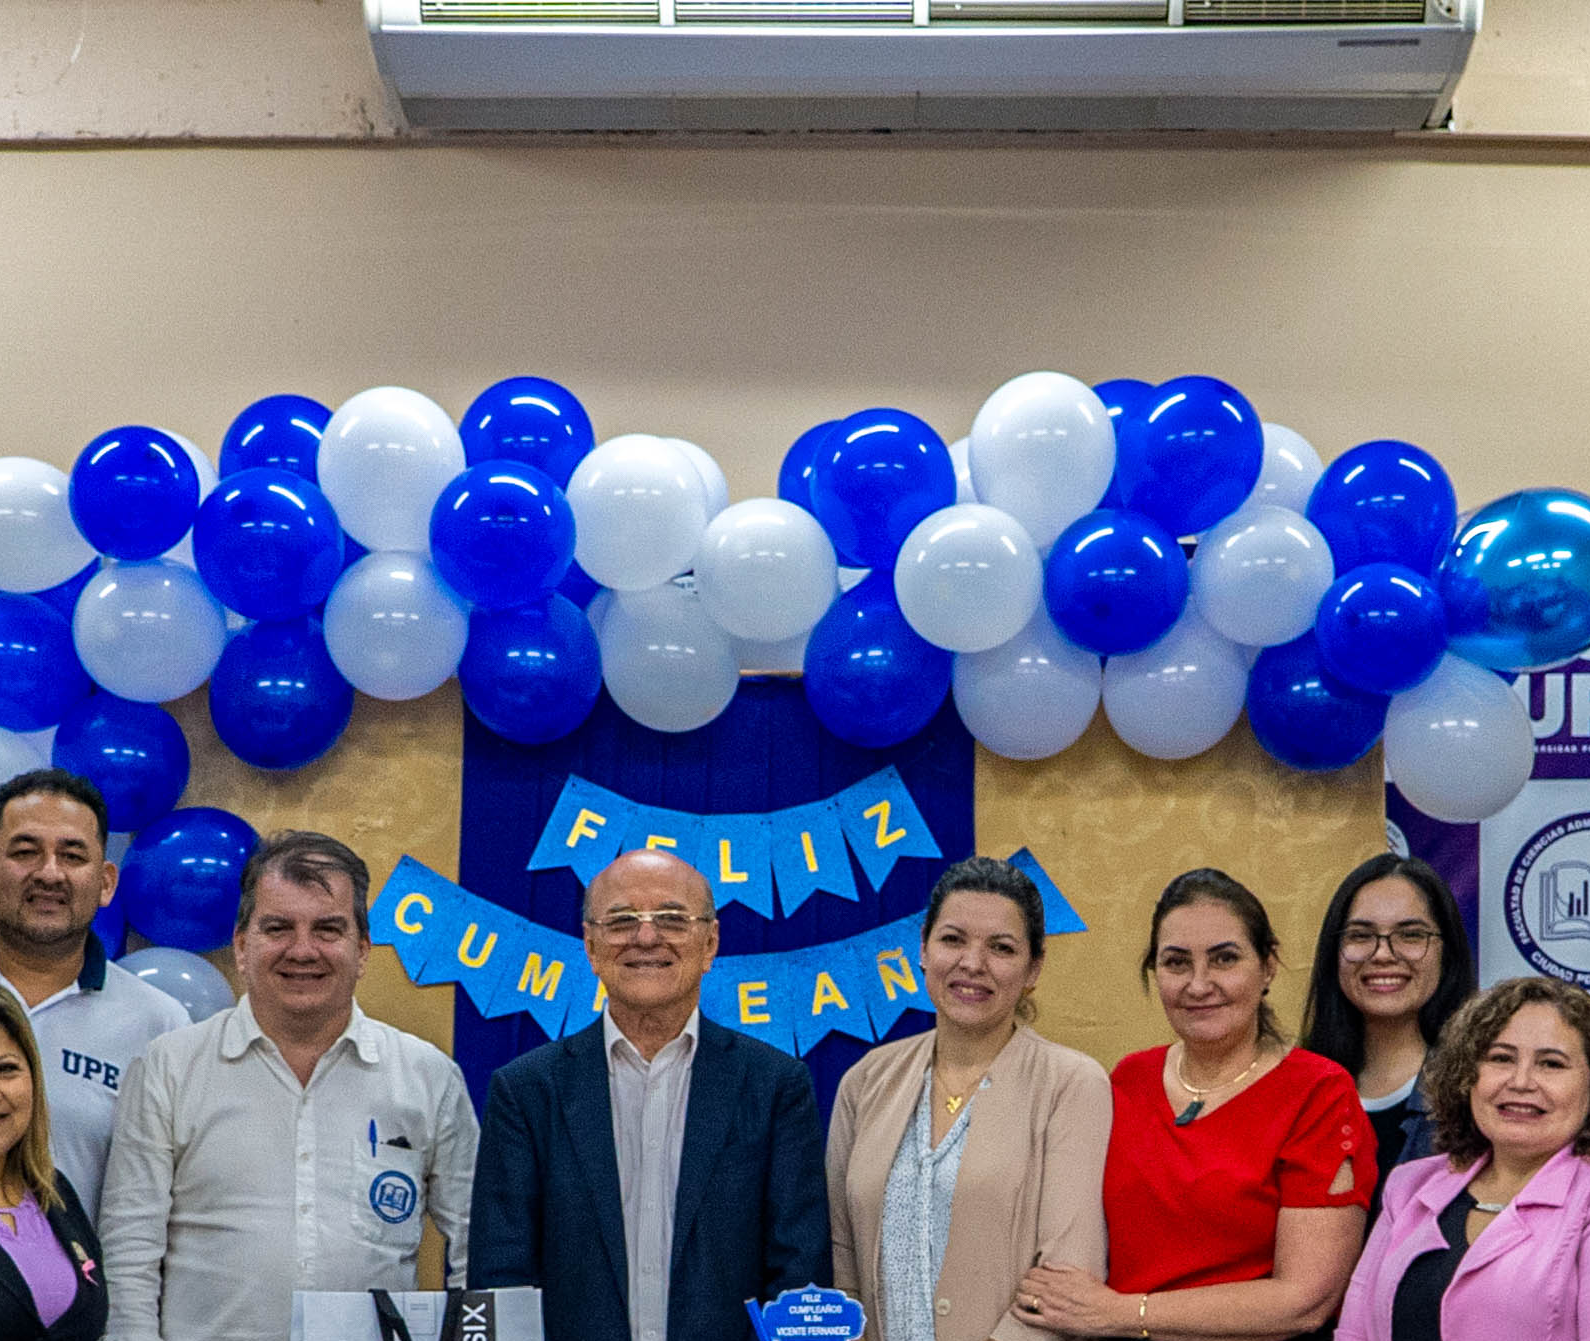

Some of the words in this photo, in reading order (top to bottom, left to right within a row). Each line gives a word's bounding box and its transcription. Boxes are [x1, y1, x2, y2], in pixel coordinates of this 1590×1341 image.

[1534, 743, 1578, 754] ERSIDAD
[1511, 867, 1526, 886] DE
[1521, 826, 1566, 867] CIENCIAS
[61, 1048, 121, 1091] UPE
[801, 1293, 822, 1303] FELIZ
[788, 1303, 843, 1314] CUMPLEAÑOS
[776, 1326, 807, 1336] VICENTE
[808, 1325, 851, 1336] FERNANDEZ
